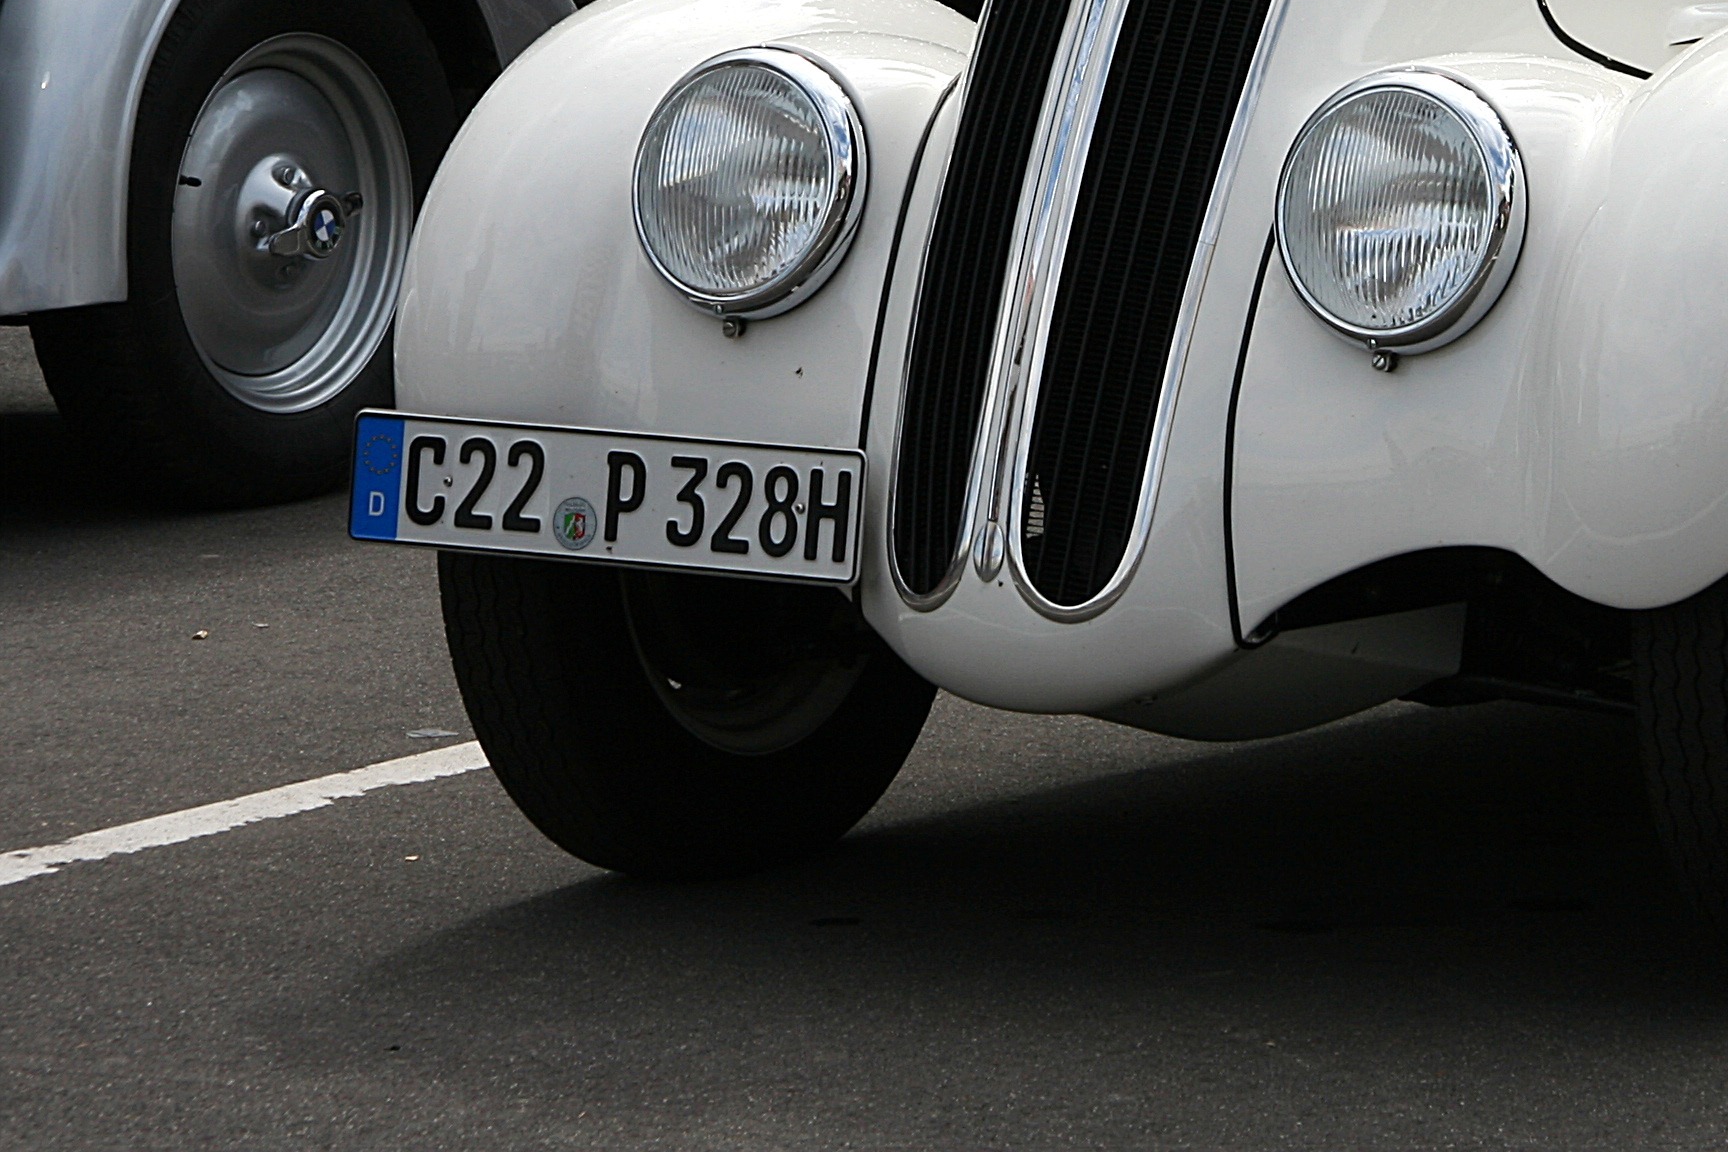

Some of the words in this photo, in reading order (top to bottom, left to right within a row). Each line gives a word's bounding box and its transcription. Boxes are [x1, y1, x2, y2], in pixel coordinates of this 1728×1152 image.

[367, 491, 386, 518] D
[404, 434, 546, 535] C22
[603, 450, 649, 545] P
[664, 456, 853, 565] 328H
